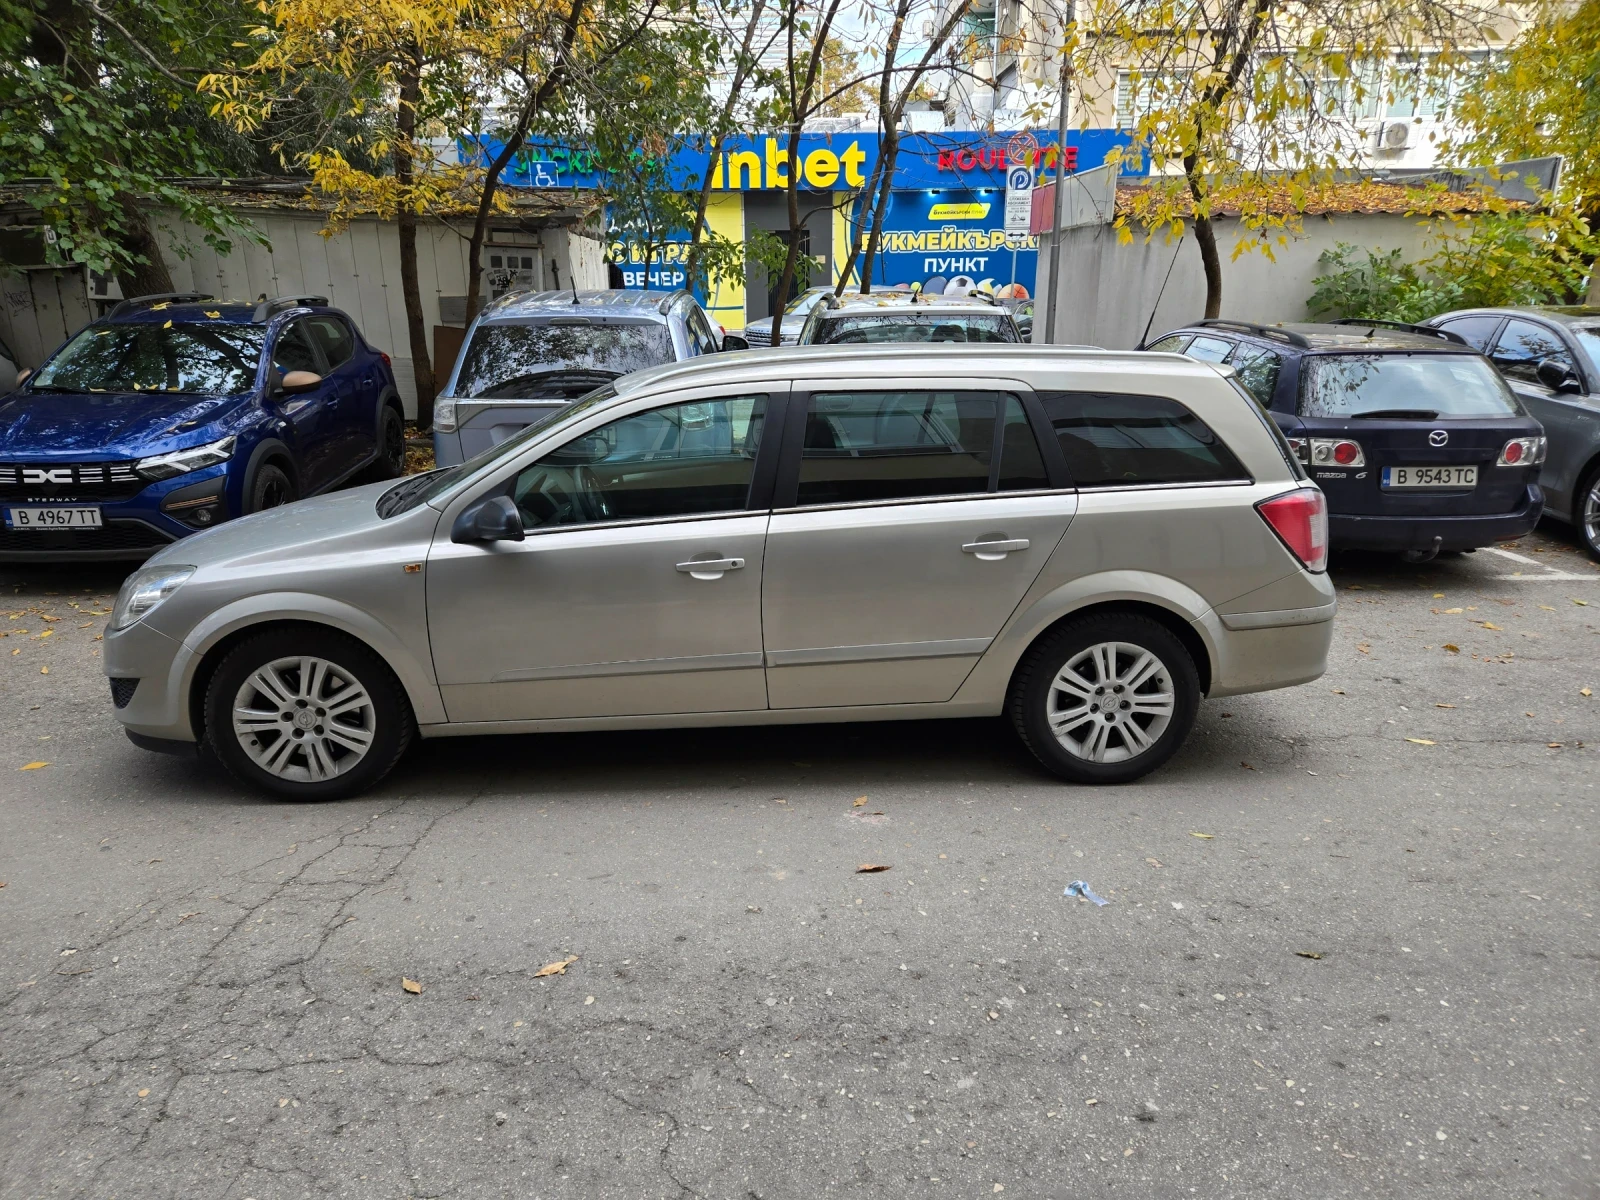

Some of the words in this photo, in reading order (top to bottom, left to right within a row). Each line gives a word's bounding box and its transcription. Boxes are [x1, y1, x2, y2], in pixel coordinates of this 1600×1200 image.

[710, 135, 866, 189] inbet
[938, 146, 1078, 171] ROULTTE
[924, 257, 988, 273] ПУНКТ
[623, 271, 684, 287] ВЕЧЕР
[1355, 471, 1368, 479] 6
[1398, 469, 1407, 484] B
[1415, 469, 1450, 484] 9543
[1455, 469, 1474, 483] TC
[18, 510, 30, 525] B
[37, 510, 73, 525] 4967
[76, 510, 97, 524] TT
